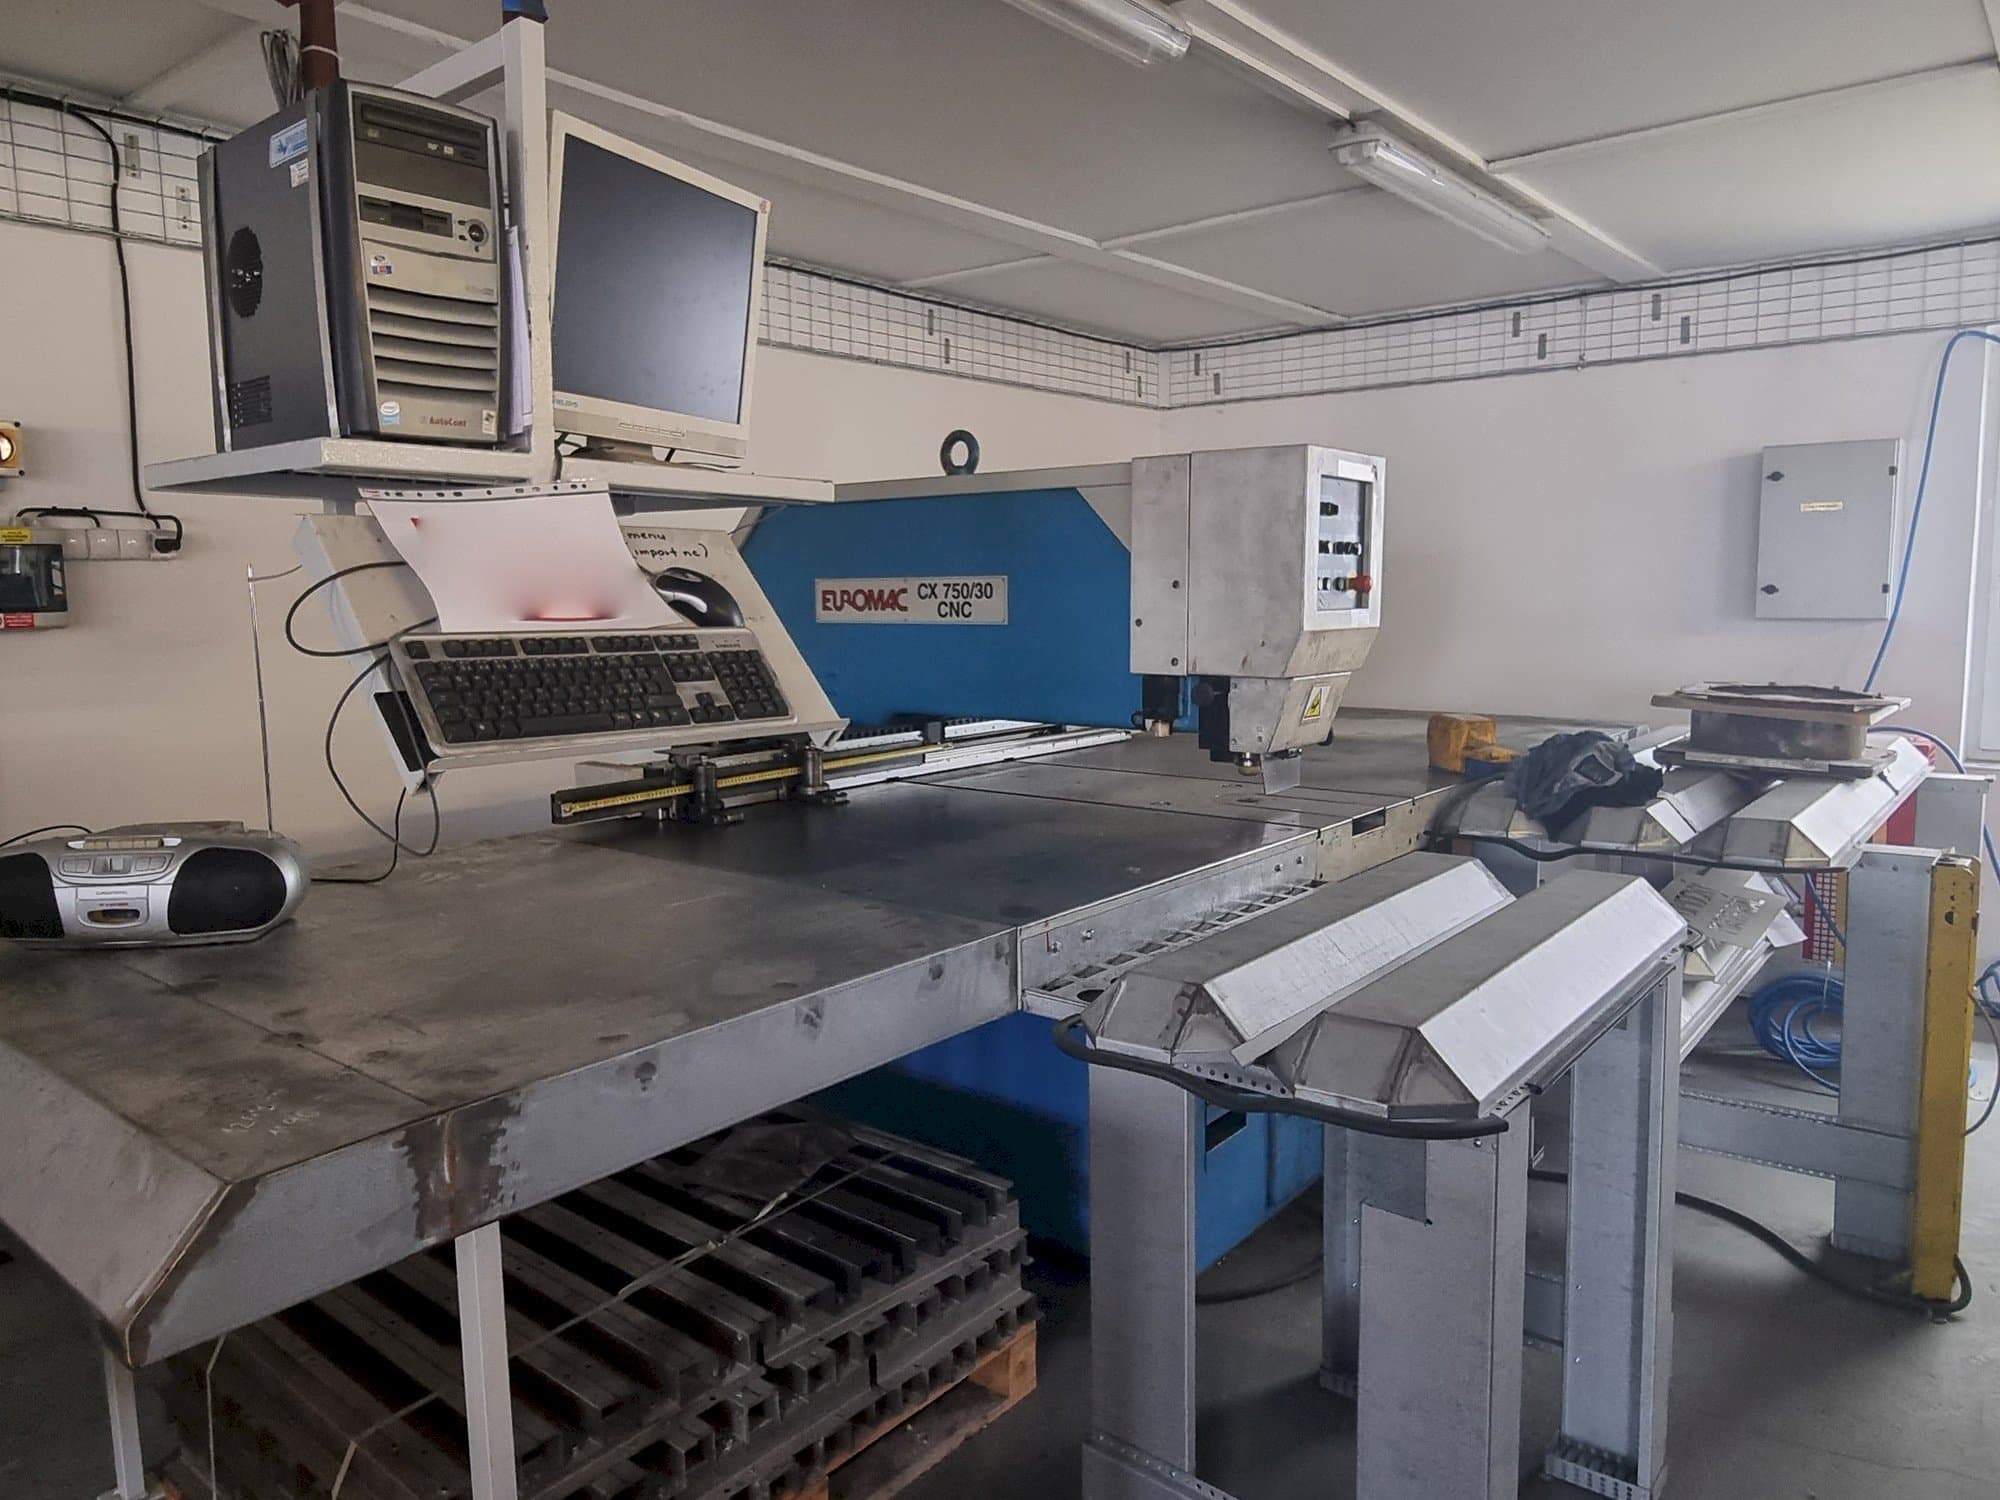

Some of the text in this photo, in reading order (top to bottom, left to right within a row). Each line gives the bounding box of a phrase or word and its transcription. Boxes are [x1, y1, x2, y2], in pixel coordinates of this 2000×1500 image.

[627, 532, 666, 541] menu
[917, 582, 993, 600] CX 750/30
[822, 588, 908, 612] EUROMAC
[937, 601, 972, 618] CNC
